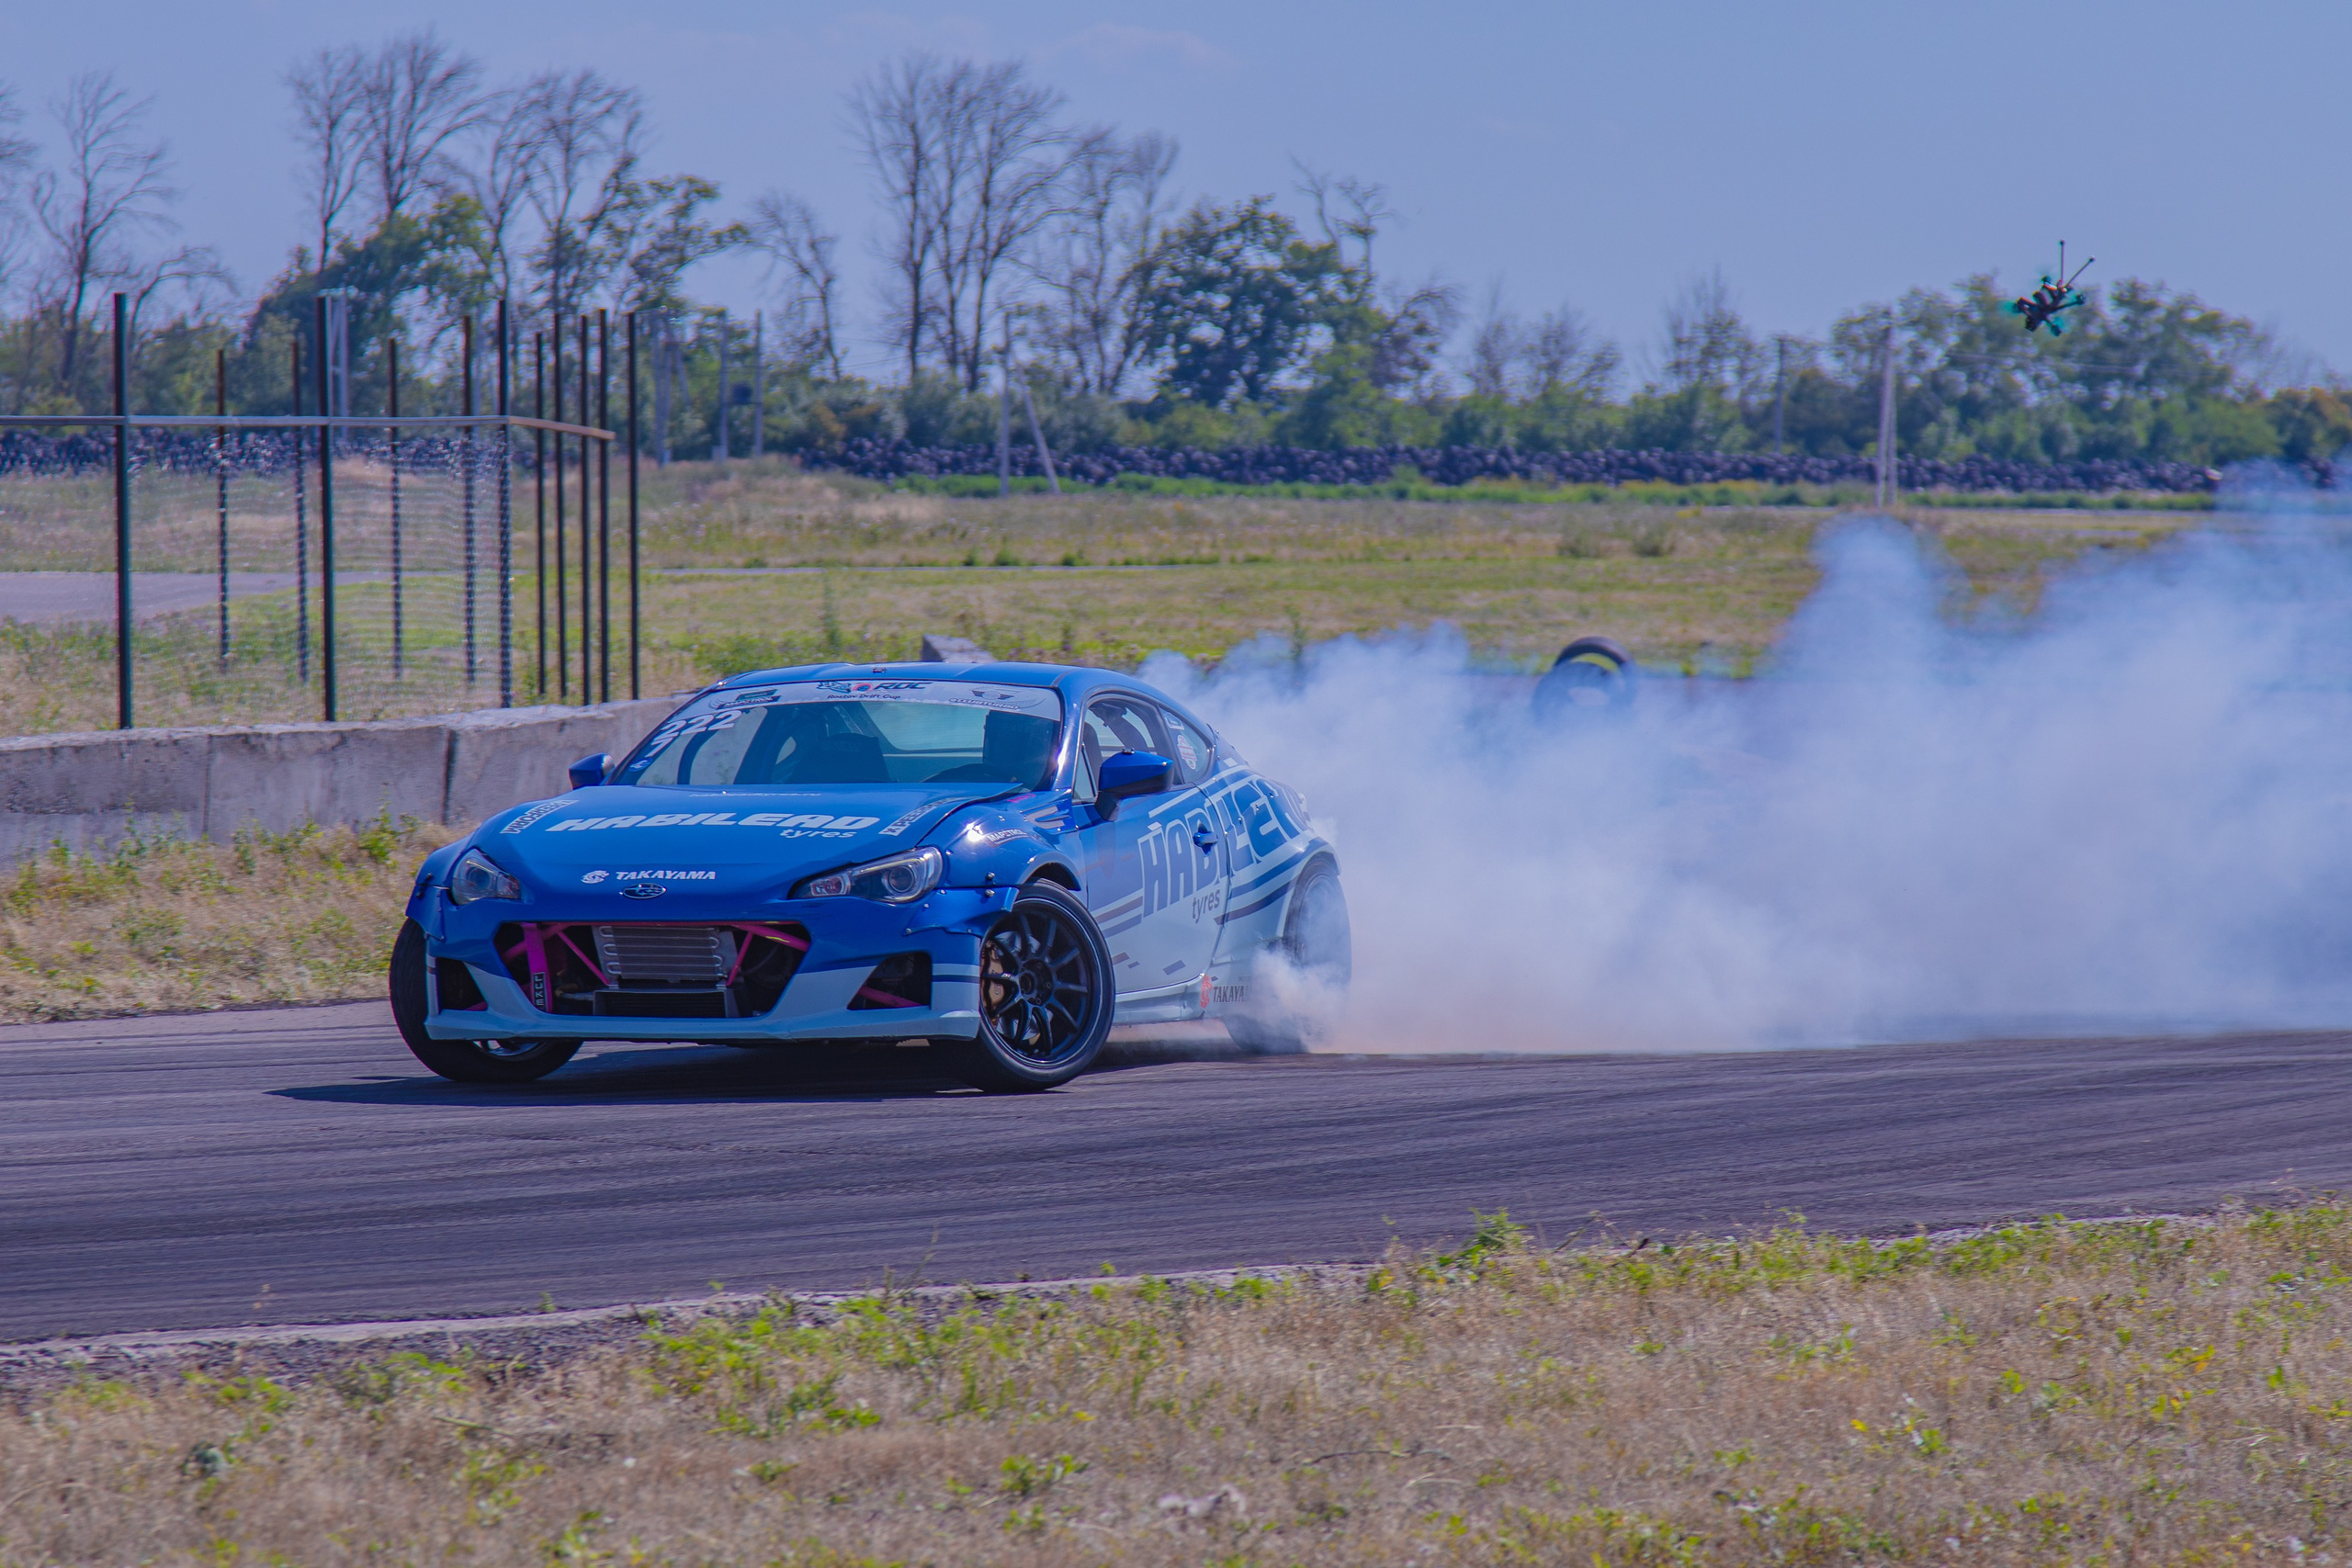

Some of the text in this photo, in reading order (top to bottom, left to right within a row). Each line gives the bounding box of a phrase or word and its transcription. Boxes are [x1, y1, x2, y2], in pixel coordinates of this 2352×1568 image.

[653, 710, 741, 741] 222
[545, 812, 880, 831] HABILEAD
[780, 828, 858, 839] tyres
[616, 870, 716, 880] TAKAYAMA
[1193, 889, 1221, 923] tyres
[534, 975, 545, 1006] LUKE
[1213, 986, 1250, 1002] TAKAYA
